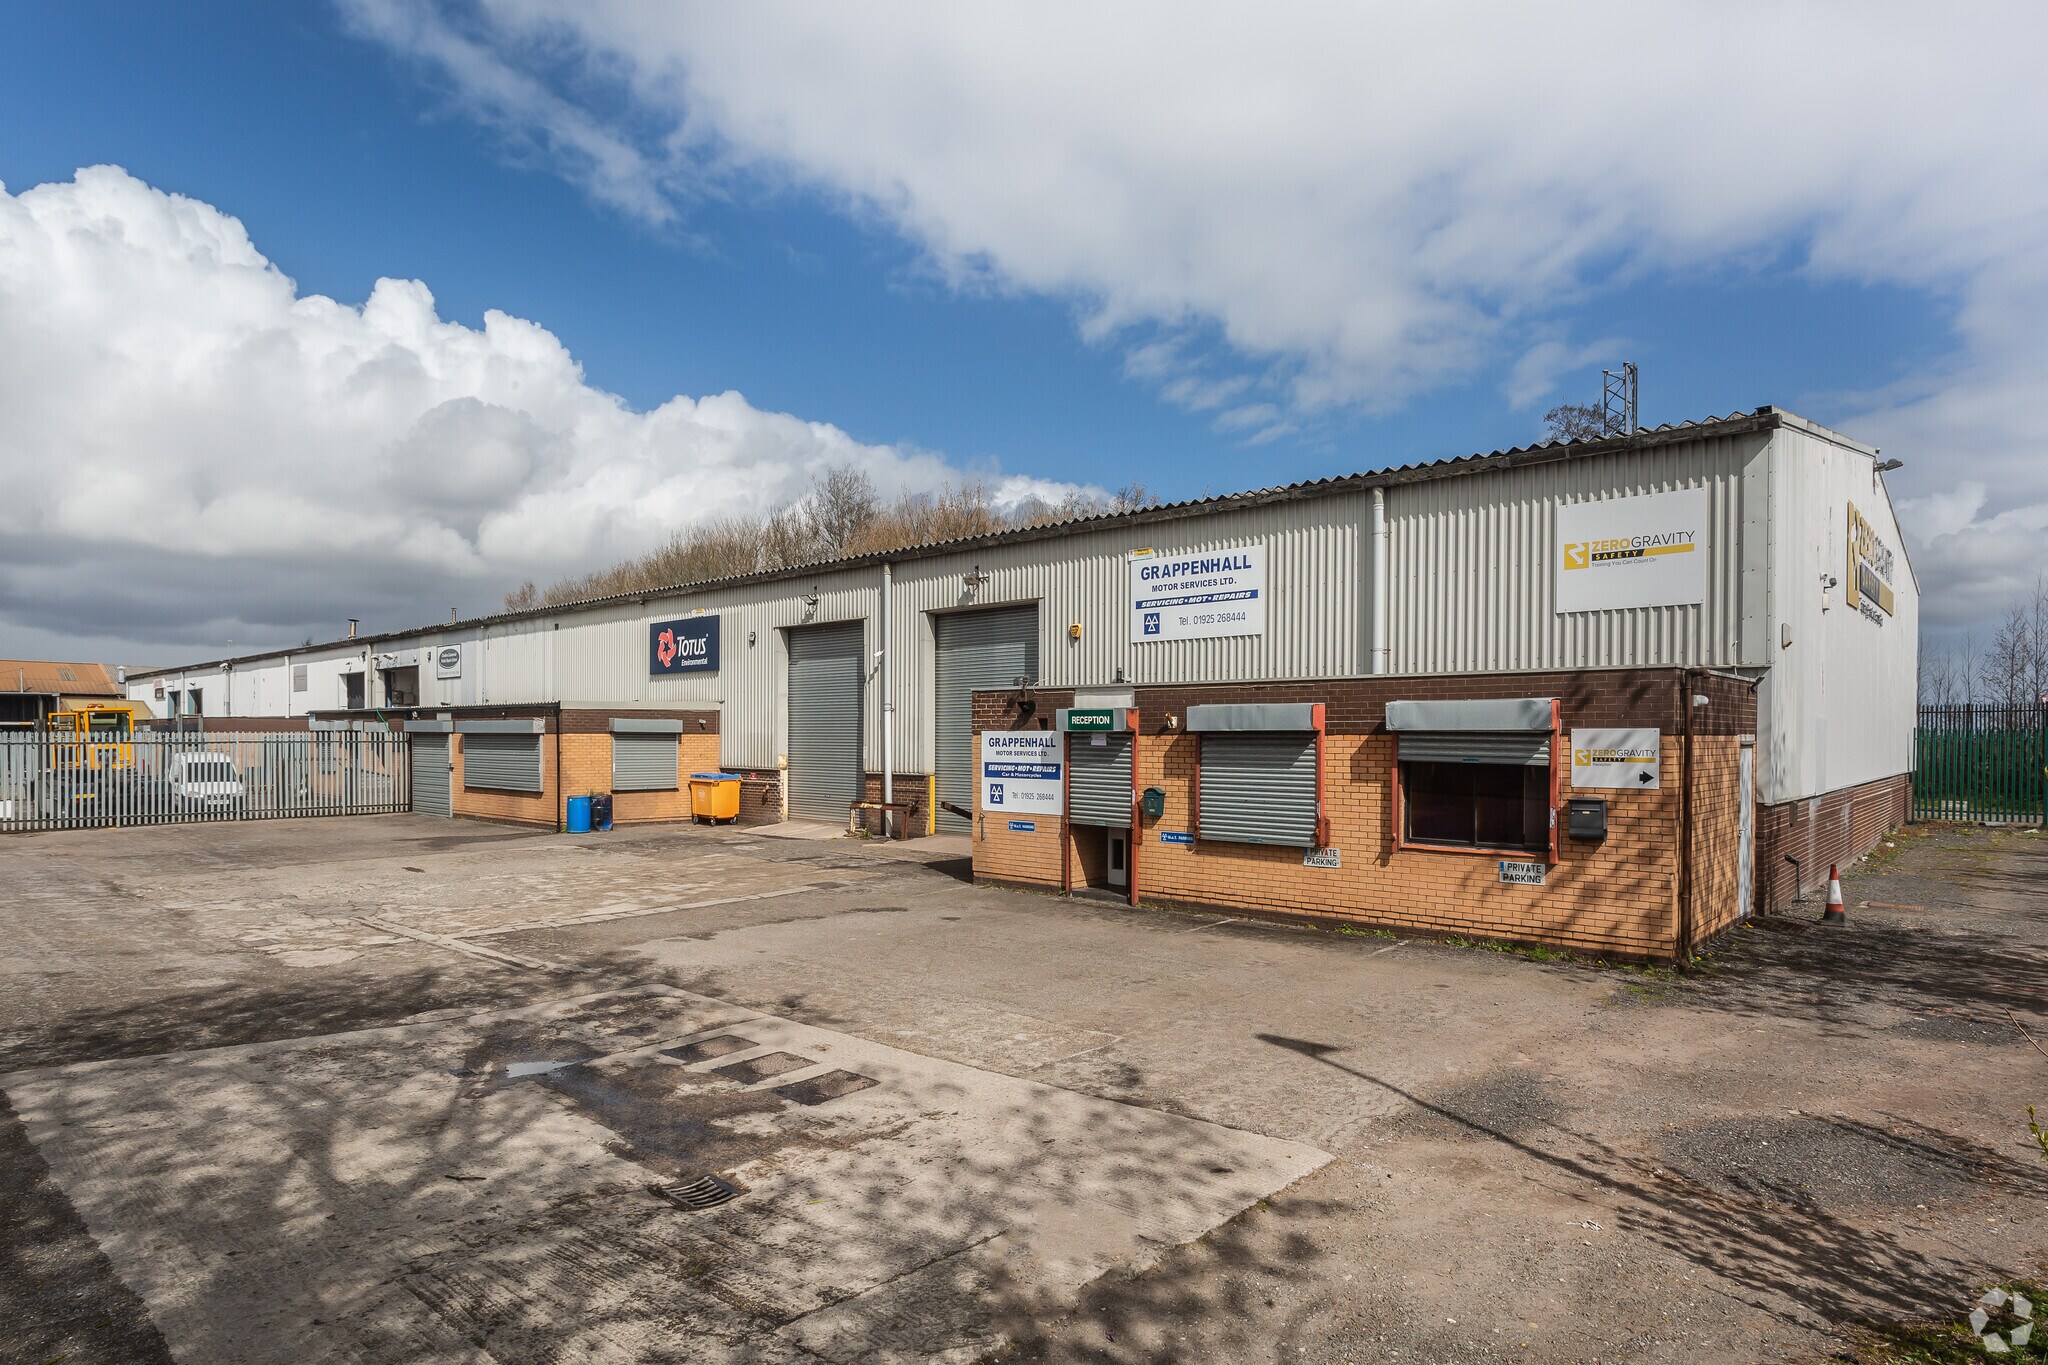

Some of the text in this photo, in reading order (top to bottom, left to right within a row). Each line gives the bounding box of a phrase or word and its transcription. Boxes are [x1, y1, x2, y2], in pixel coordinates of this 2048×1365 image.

[1595, 550, 1638, 561] SAFETY
[1633, 557, 1648, 565] Count
[1140, 554, 1252, 581] GRAPPENHALL
[1151, 577, 1237, 593] MOTOR SERVICES LTD.
[1212, 591, 1252, 601] REPAIRS
[1178, 612, 1246, 626] Tel. 01925 268444
[681, 657, 708, 667] Environmental
[1071, 715, 1110, 725] RECEPTION
[988, 737, 1057, 748] GRAPPENHALL
[1032, 765, 1057, 773] REPAIRS
[1012, 791, 1055, 801] Tel. 01925 268444
[1310, 848, 1338, 857] PRIVATE
[1306, 857, 1337, 867] PARKING
[1507, 863, 1542, 874] PRIVATE
[1502, 873, 1541, 884] PARKING
